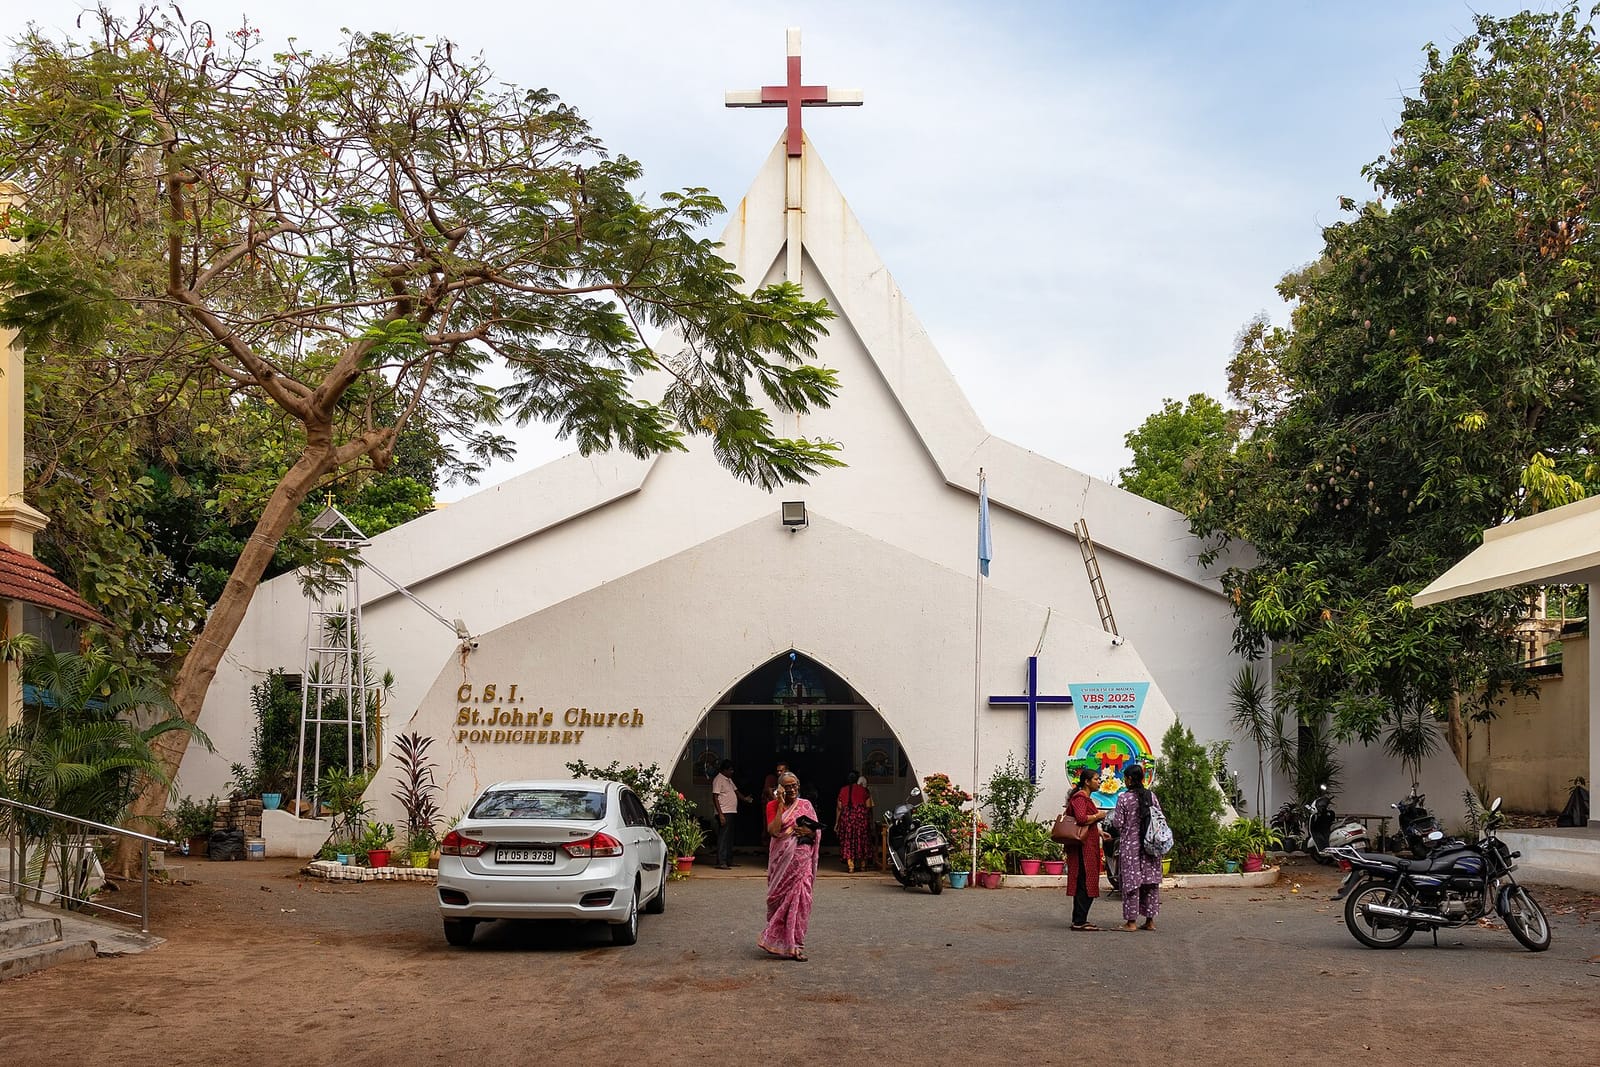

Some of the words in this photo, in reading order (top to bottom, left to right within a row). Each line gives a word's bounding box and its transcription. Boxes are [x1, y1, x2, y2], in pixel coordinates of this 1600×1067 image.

[1082, 694, 1104, 702] VBS
[1108, 693, 1136, 702] 2025
[564, 707, 645, 727] Church
[457, 729, 584, 744] PONDICHERRY
[498, 851, 509, 860] PY
[511, 851, 522, 860] 05
[523, 851, 529, 860] B
[531, 851, 553, 860] 3798
